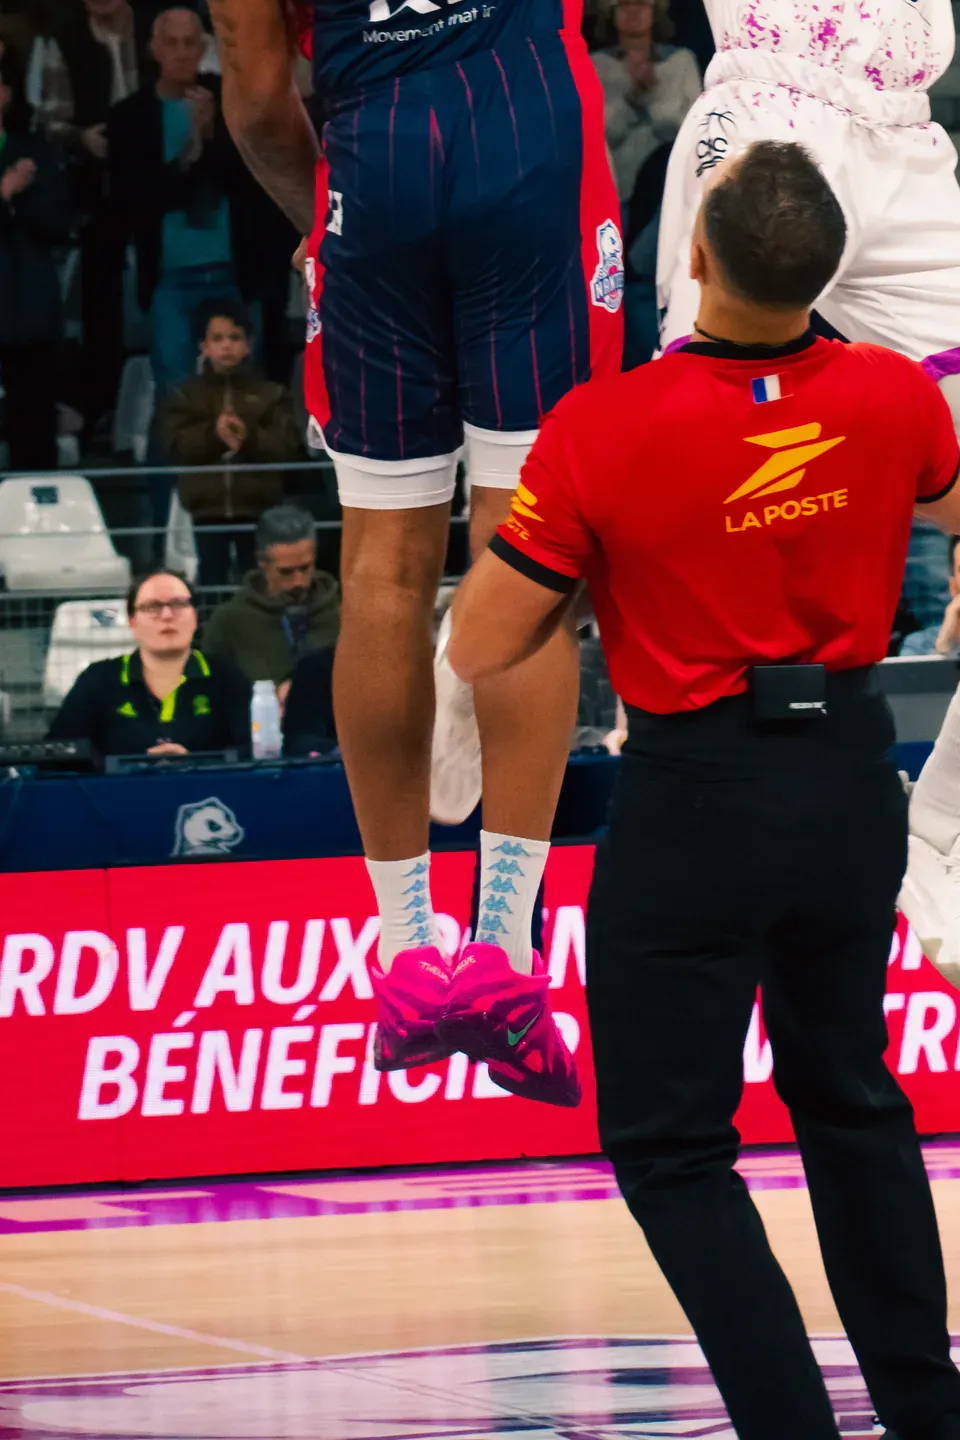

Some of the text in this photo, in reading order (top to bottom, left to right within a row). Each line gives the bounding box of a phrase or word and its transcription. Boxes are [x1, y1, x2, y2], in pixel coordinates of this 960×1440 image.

[363, 20, 445, 44] Movement
[725, 488, 848, 533] LA POSTE
[0, 926, 185, 1017] RDV
[194, 918, 379, 1007] AUX
